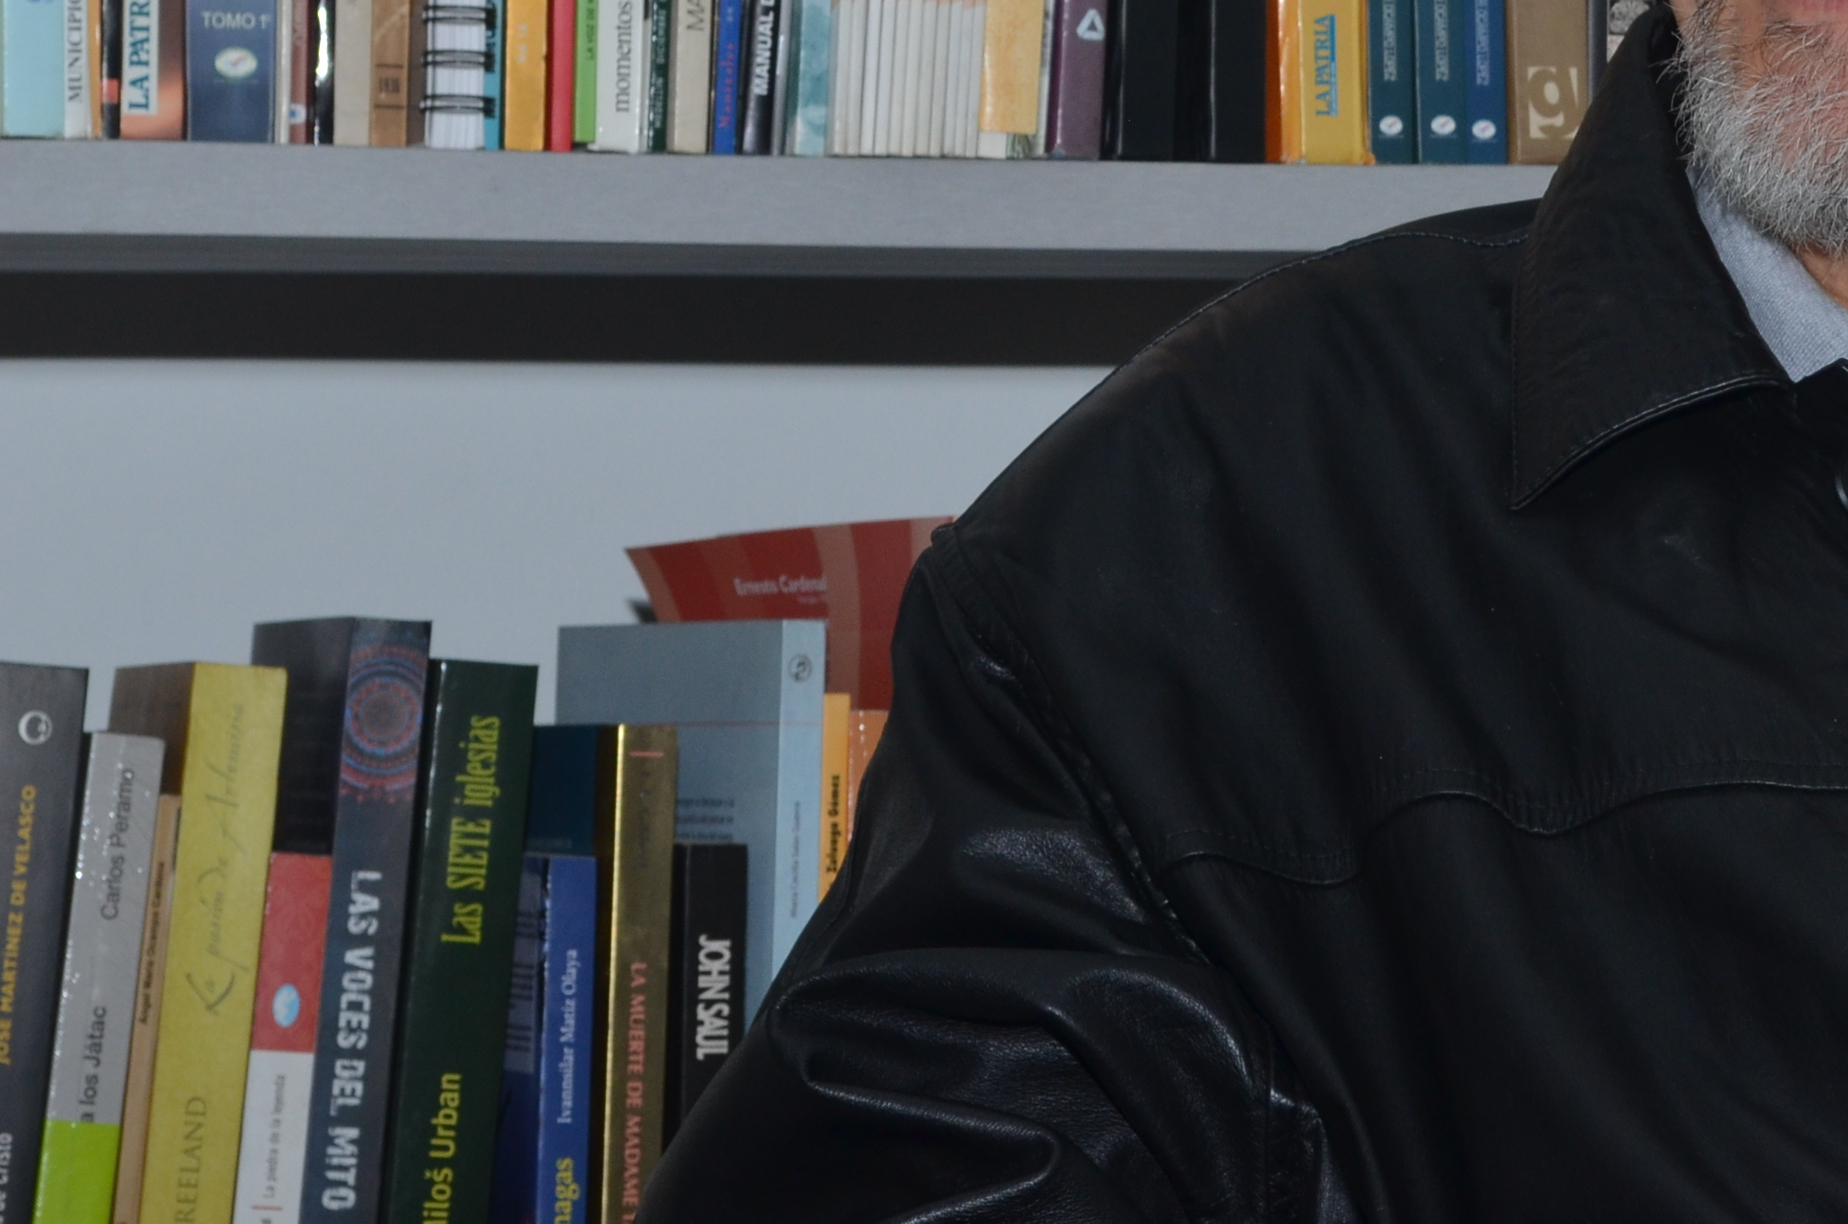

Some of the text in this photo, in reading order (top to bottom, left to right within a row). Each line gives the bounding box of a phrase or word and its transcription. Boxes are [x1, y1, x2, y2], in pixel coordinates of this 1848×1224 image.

[128, 72, 153, 111] LA
[613, 0, 633, 113] momentos
[753, 10, 775, 96] MANUAL
[1313, 16, 1332, 117] LA PATRIA
[99, 767, 135, 920] Carlos Peramo
[440, 714, 502, 944] Las SIETE iglesias
[321, 870, 384, 1211] LAS VOCES DEL MITO
[695, 934, 732, 1060] JOHN SAUL
[262, 1074, 287, 1199] La piedra de la leyenda
[623, 962, 648, 1206] LA MUERTE DE MADAME
[422, 1072, 462, 1224] iloš Urban
